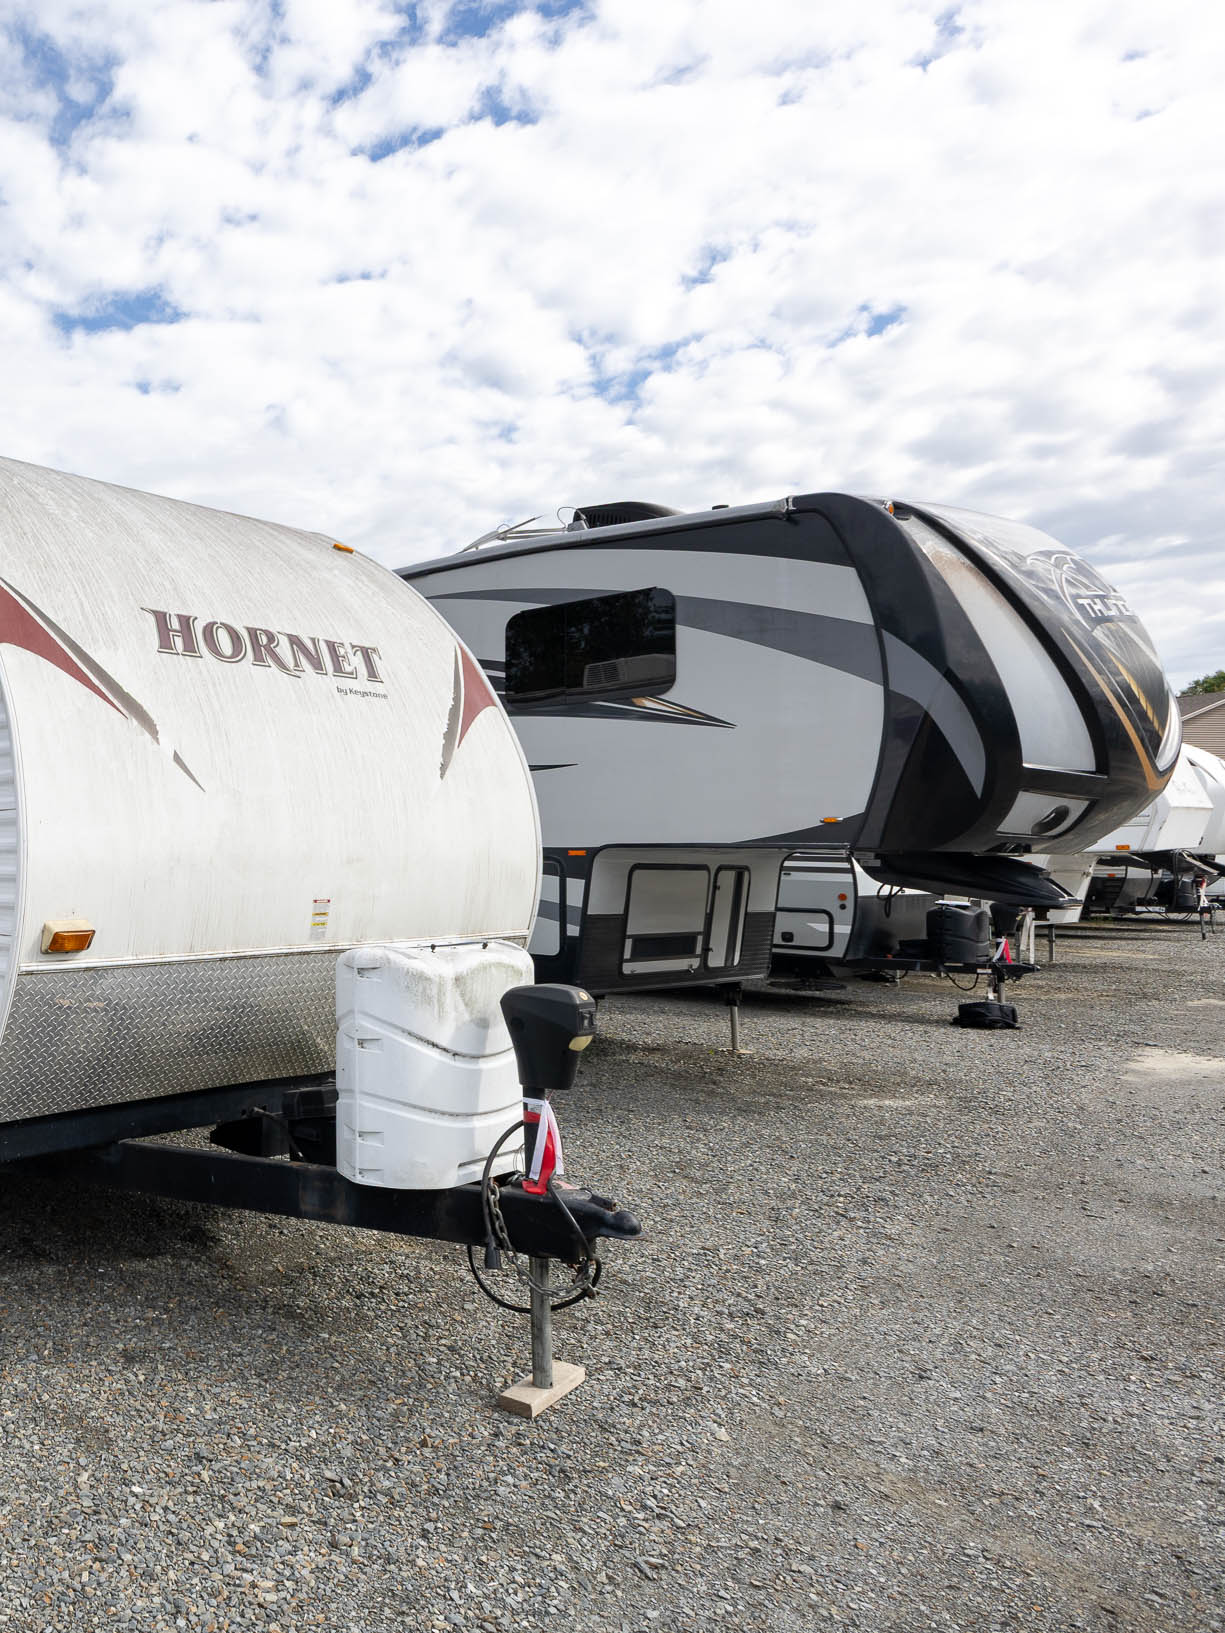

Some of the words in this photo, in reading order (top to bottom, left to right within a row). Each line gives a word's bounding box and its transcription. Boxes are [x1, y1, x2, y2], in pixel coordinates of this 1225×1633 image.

[140, 607, 384, 684] HORNET
[336, 685, 348, 696] by
[348, 687, 389, 700] Keystone
